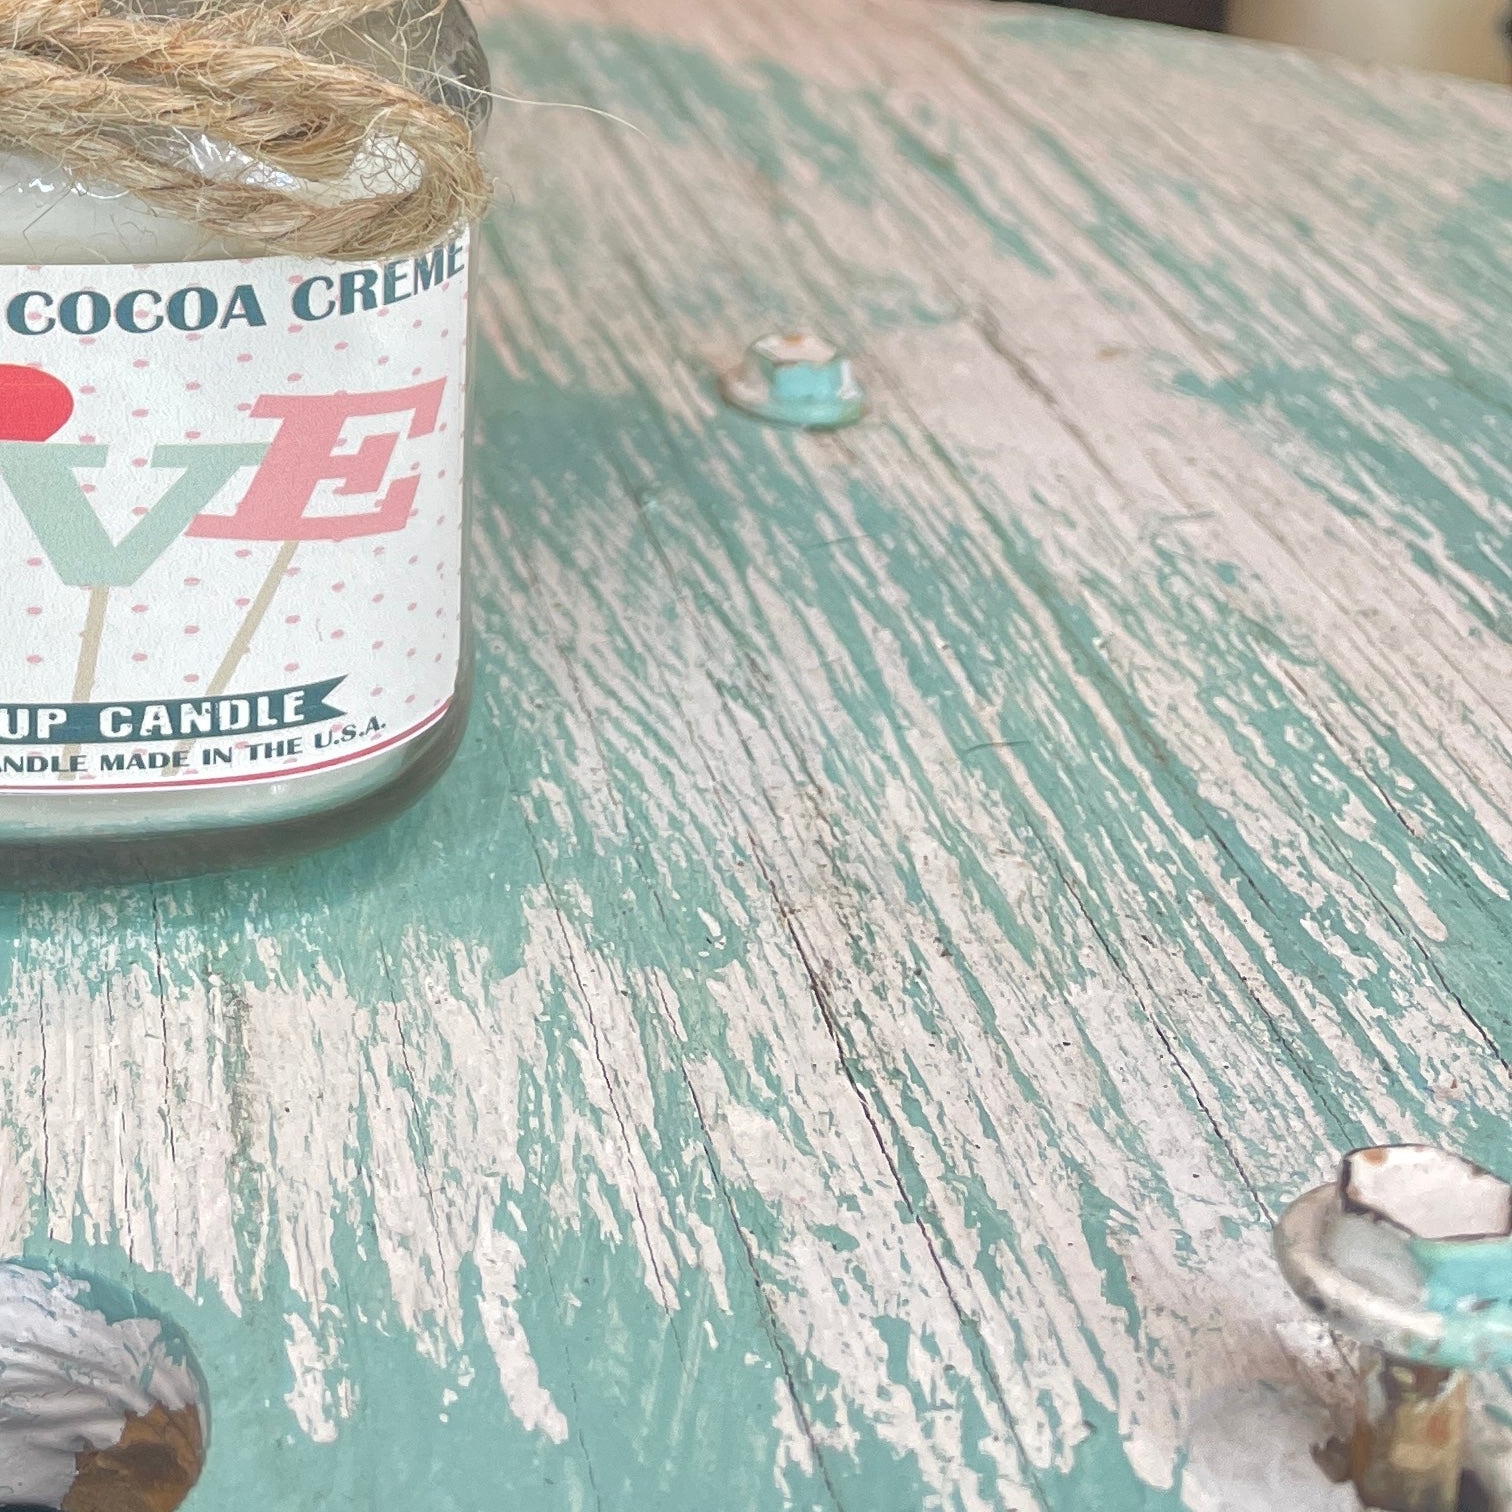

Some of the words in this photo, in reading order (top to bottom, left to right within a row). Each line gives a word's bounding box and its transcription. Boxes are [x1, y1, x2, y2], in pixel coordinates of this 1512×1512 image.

[6, 284, 267, 336] COCOA
[291, 239, 465, 322] CREME
[98, 690, 306, 738] CANDLE
[99, 749, 191, 772] MADE
[201, 746, 234, 766] IN
[243, 737, 304, 763] THE
[313, 715, 387, 749] U.S.A.
